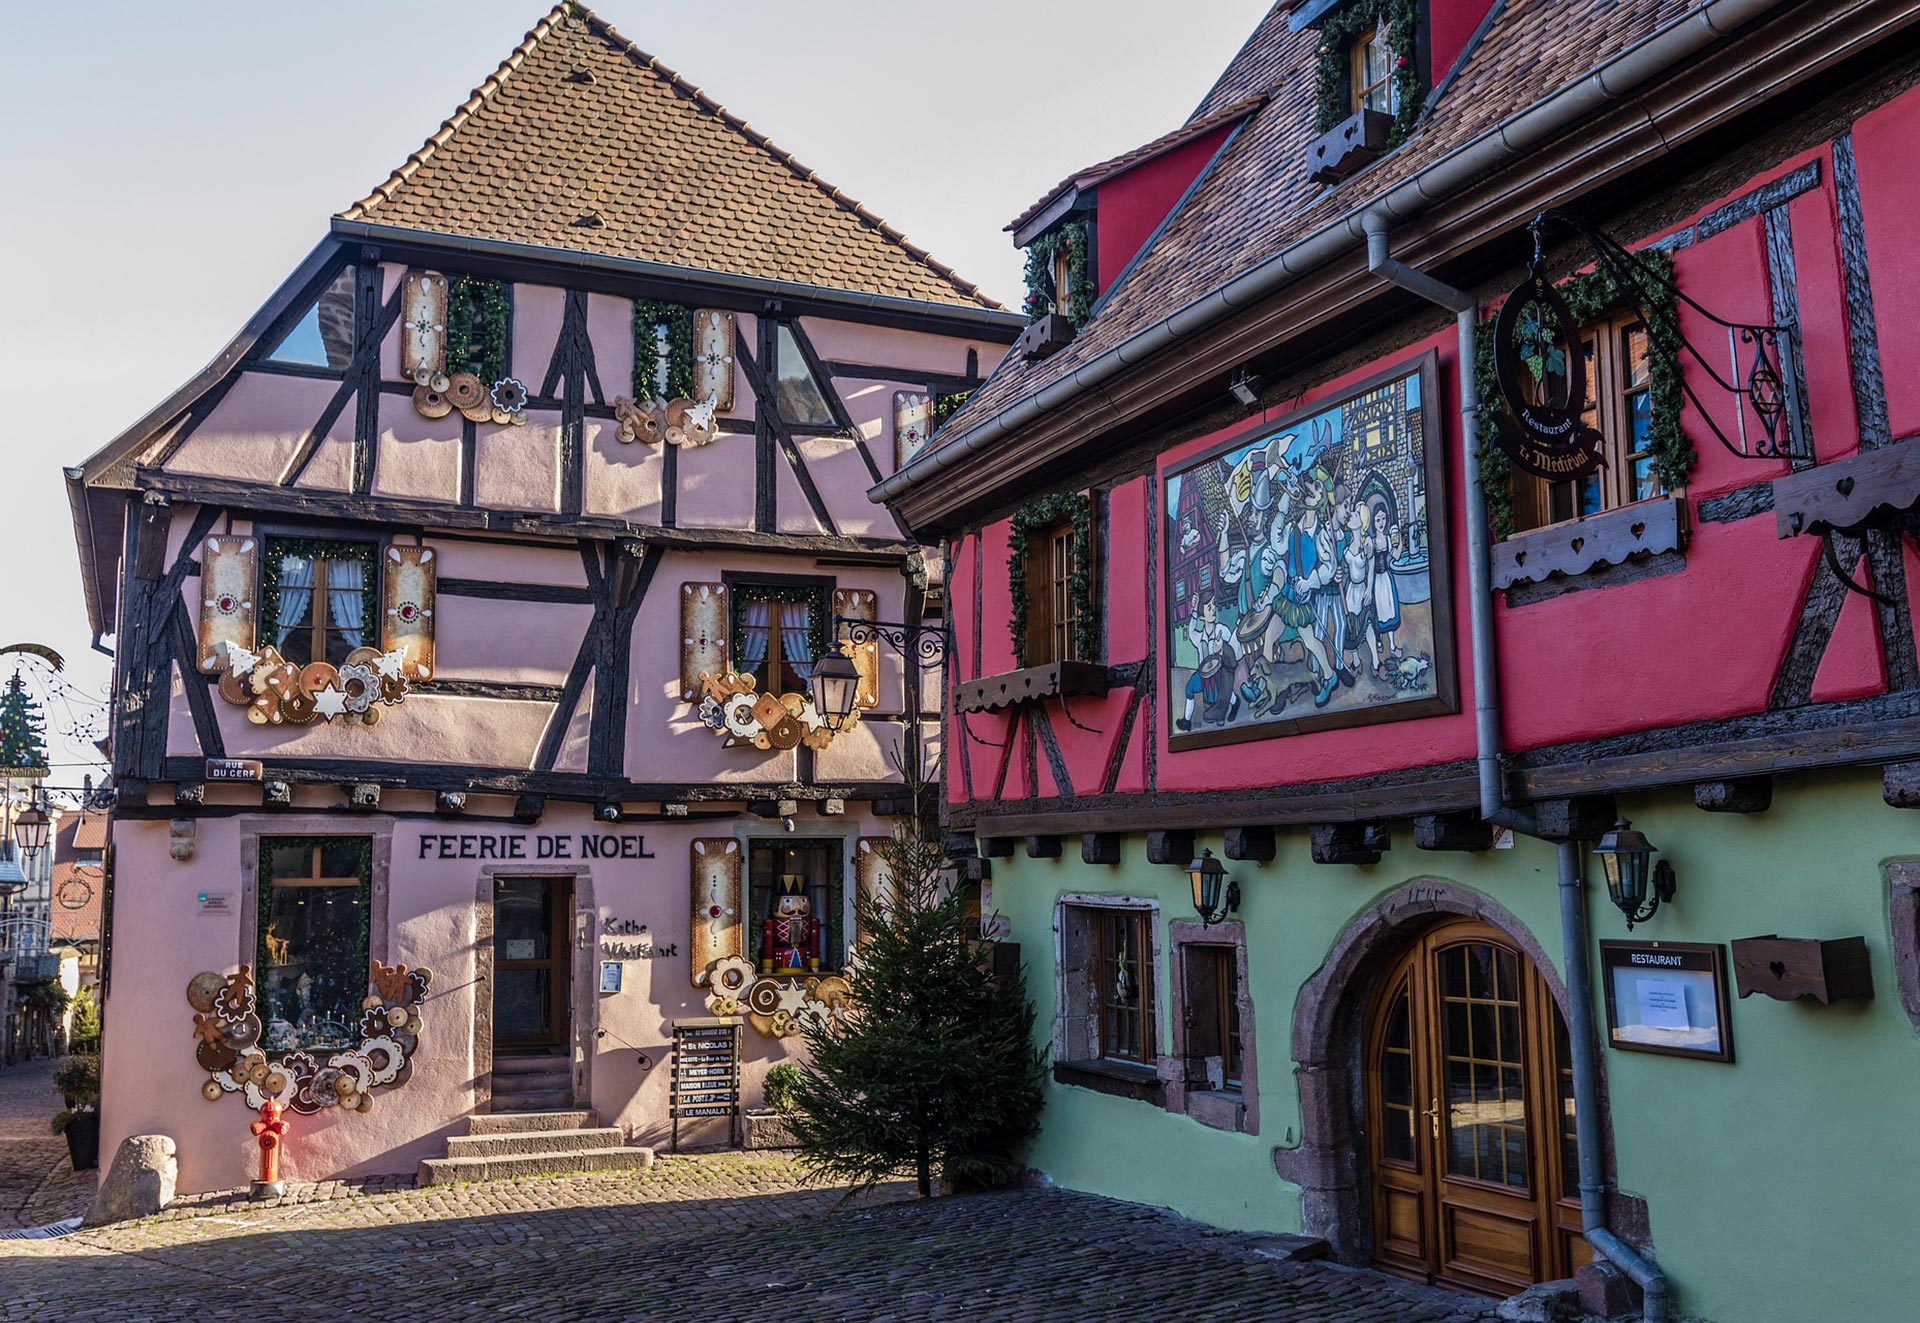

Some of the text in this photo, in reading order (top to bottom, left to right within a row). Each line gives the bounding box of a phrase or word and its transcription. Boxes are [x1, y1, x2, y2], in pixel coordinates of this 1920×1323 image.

[1521, 408, 1573, 434] Restaurant
[1533, 447, 1589, 473] Médiéval
[213, 769, 255, 777] DU CERF
[419, 835, 655, 859] FEERIE DE NOEL
[1631, 953, 1683, 966] RESTAURANT
[688, 1041, 728, 1050] St NICOLAS
[680, 1082, 701, 1090] MAISON
[683, 1095, 691, 1103] LA
[694, 1108, 726, 1116] MANALA
